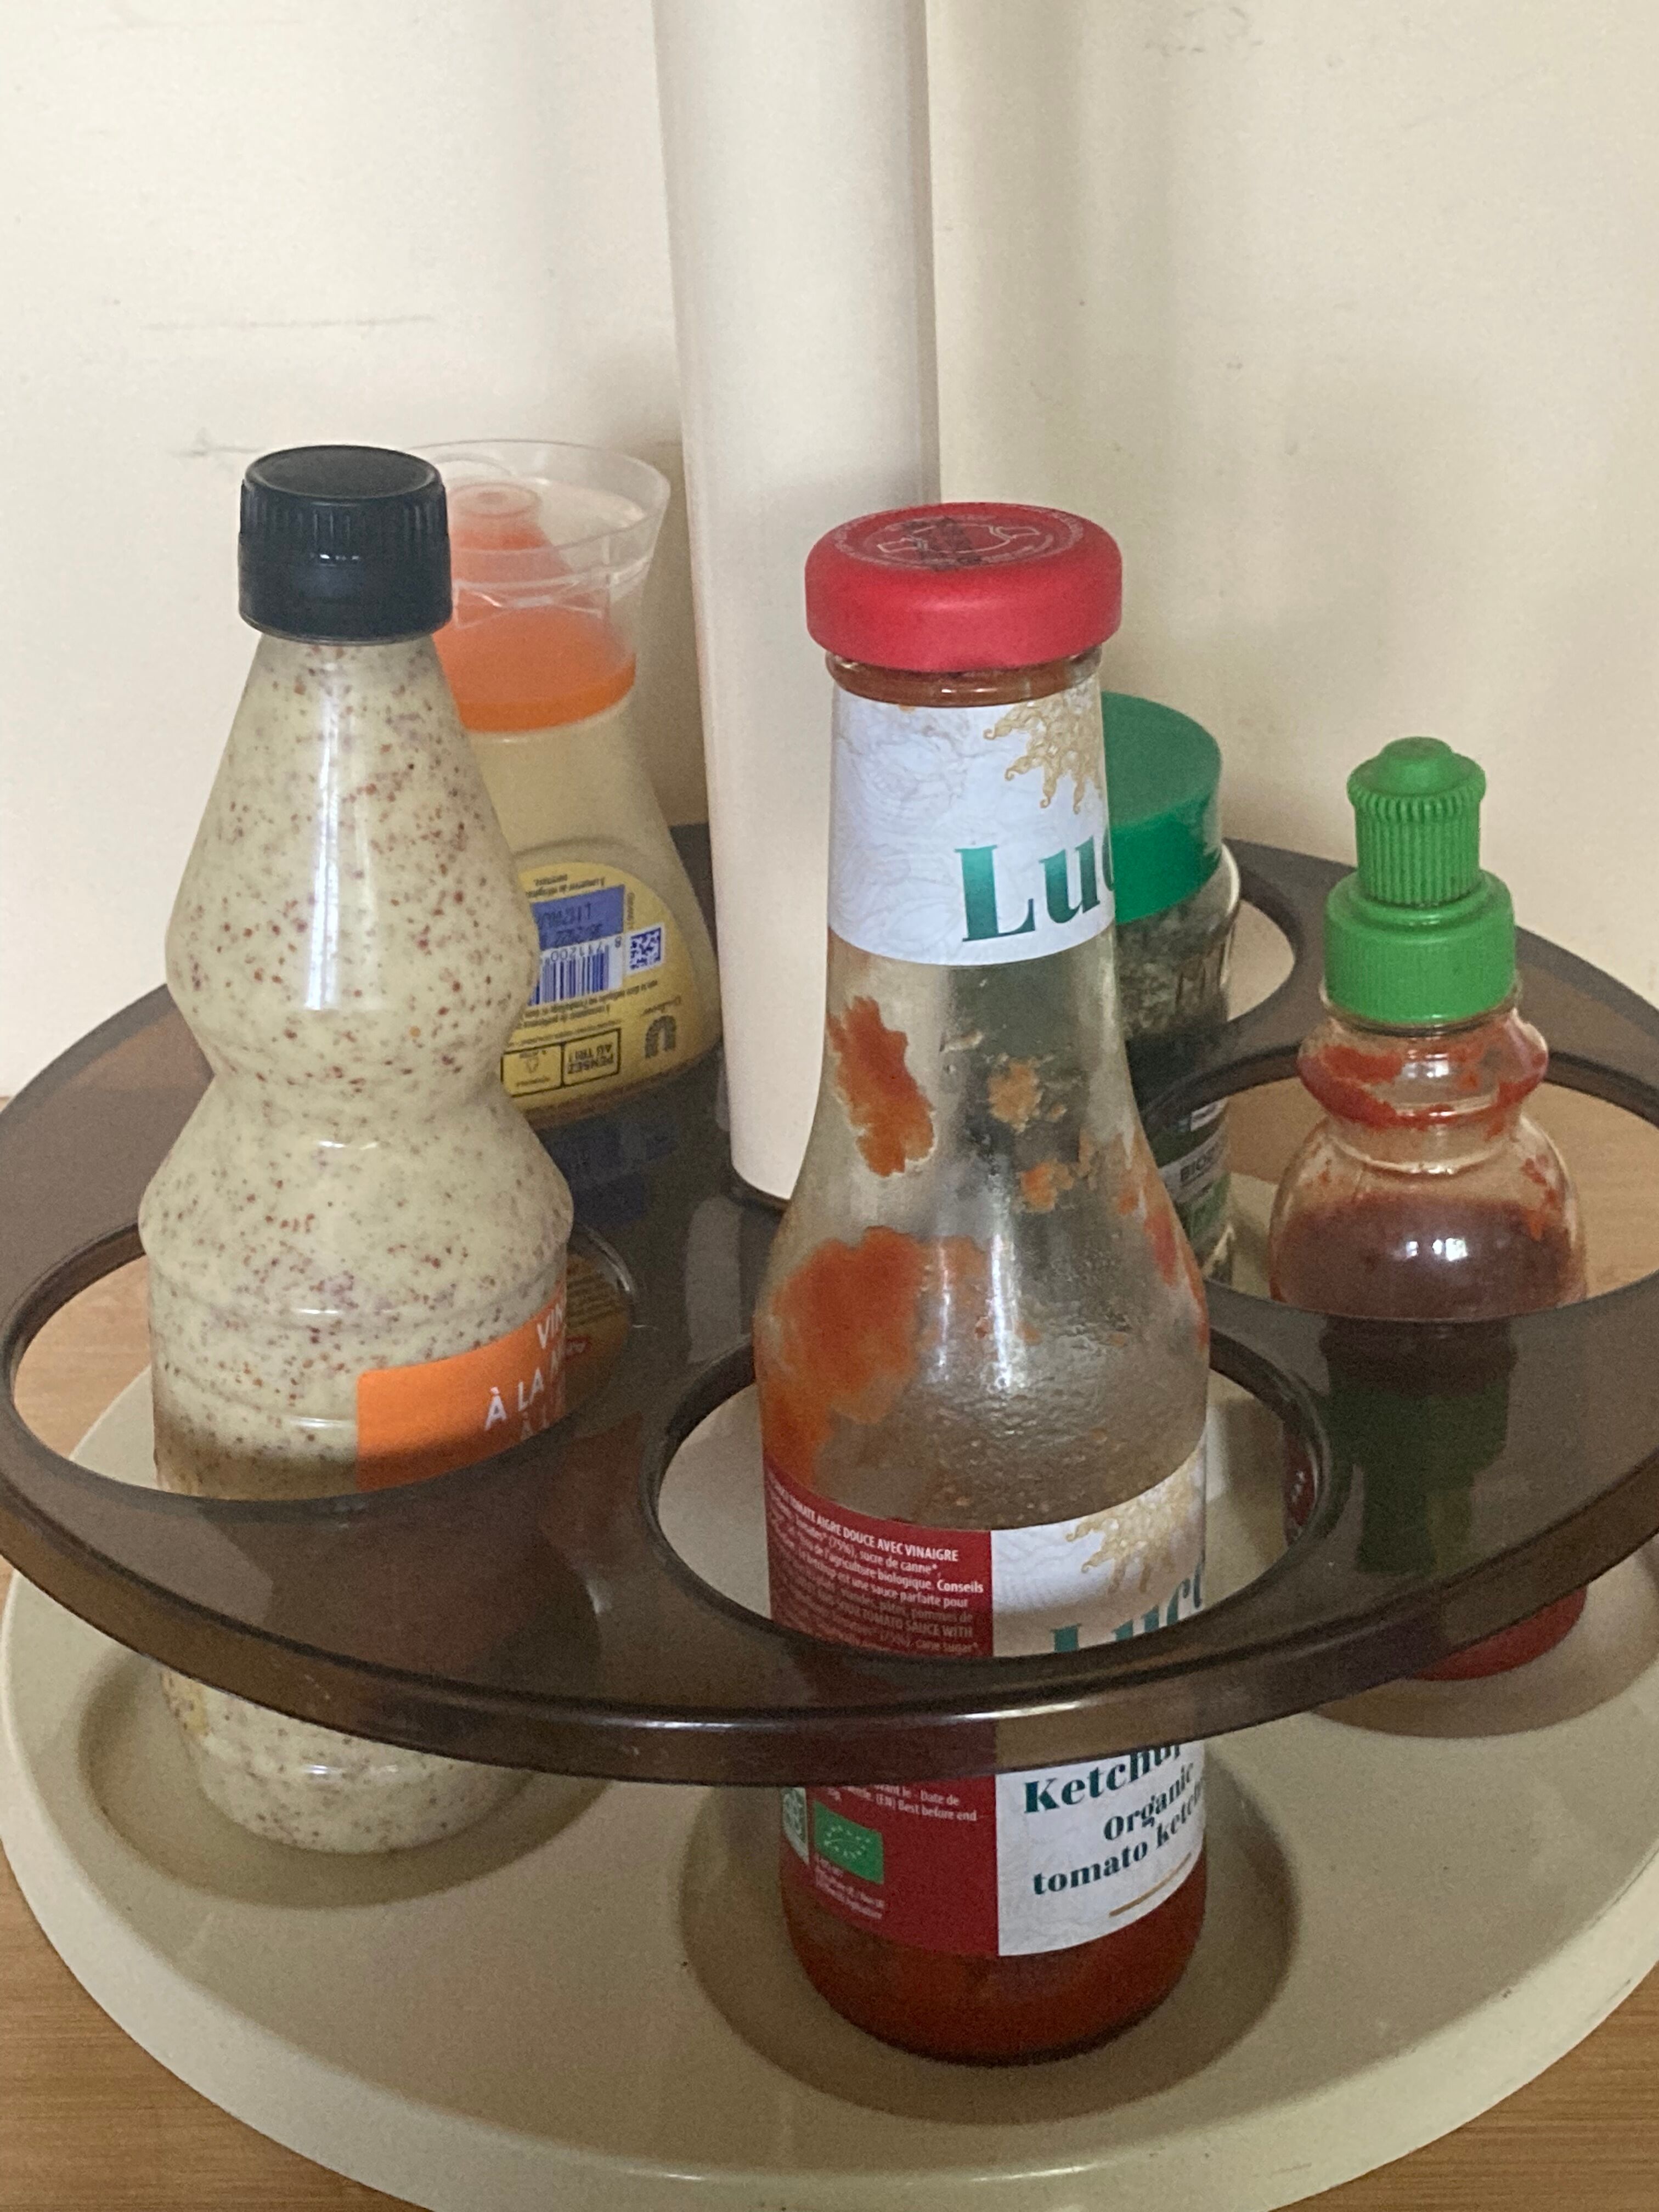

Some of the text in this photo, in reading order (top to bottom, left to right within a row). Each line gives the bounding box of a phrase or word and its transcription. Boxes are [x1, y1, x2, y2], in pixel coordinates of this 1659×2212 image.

[843, 1526, 876, 1548] DOUCE
[877, 1538, 904, 1555] AVEC
[905, 1543, 959, 1562] VINAIGRE
[936, 1578, 984, 1594] Conseils
[943, 1597, 969, 1609] pour
[1024, 1745, 1180, 1814] Ketchu
[897, 1798, 920, 1815] Best
[921, 1804, 955, 1821] before
[956, 1809, 978, 1822] end
[1033, 1841, 1148, 1895] tomato
